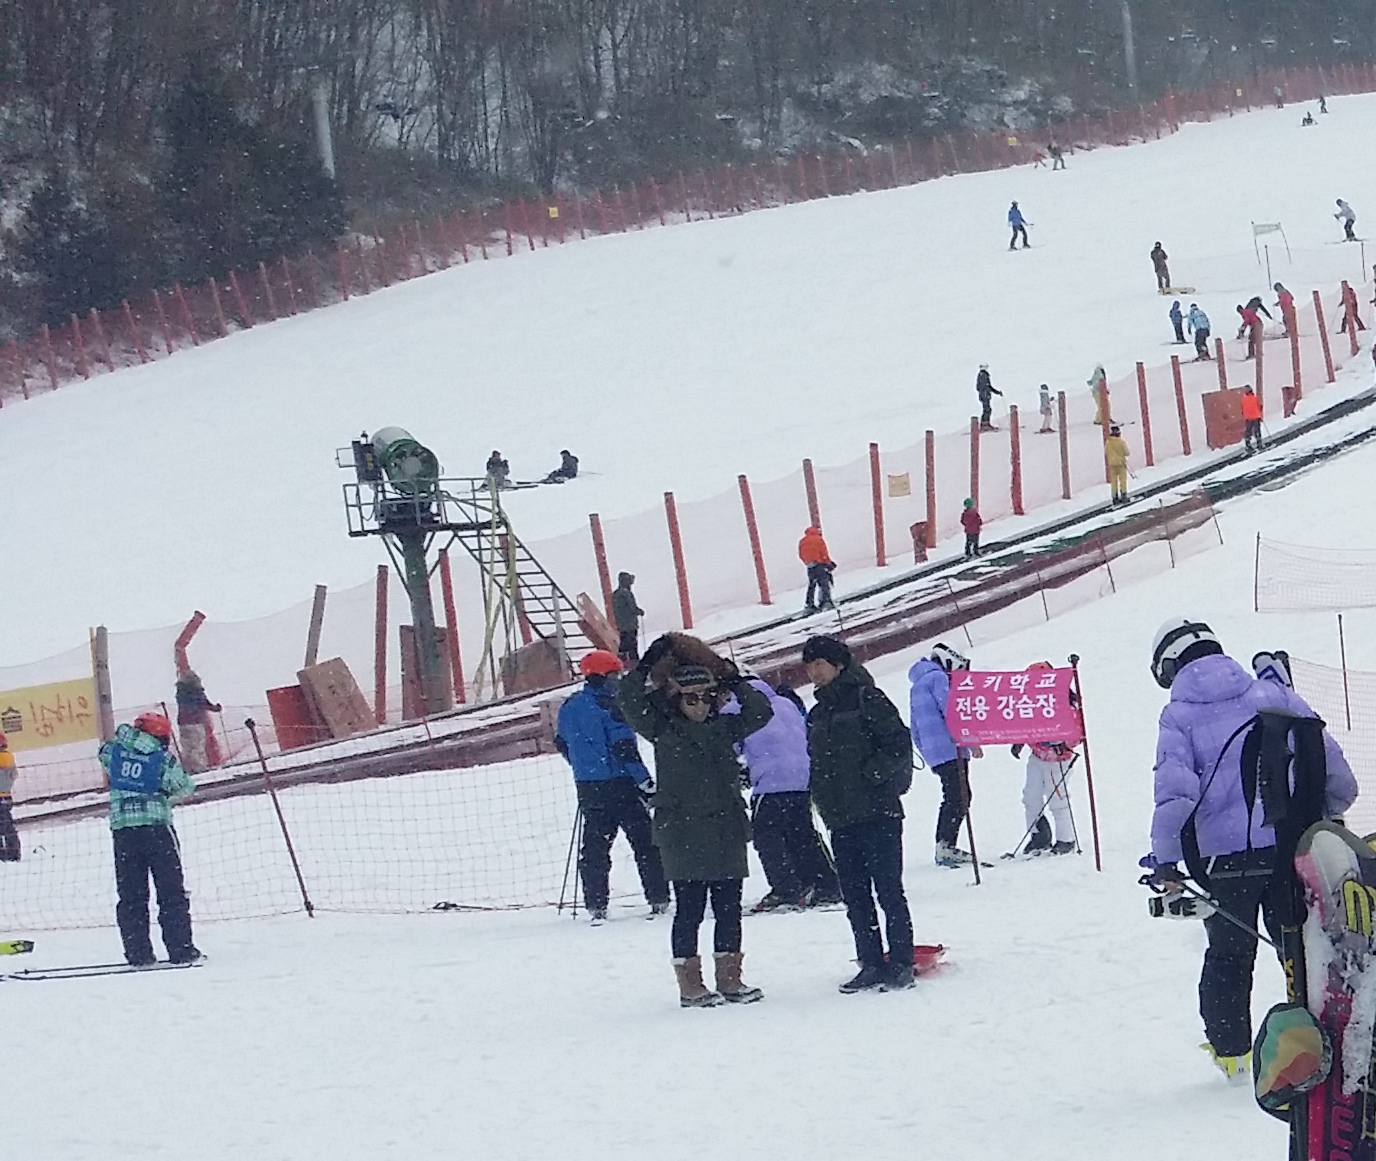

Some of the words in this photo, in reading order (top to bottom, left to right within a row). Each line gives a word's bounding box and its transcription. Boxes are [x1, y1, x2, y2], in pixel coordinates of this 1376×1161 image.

[956, 696, 990, 721] 전용
[997, 694, 1056, 719] 강습장
[121, 761, 142, 779] 80
